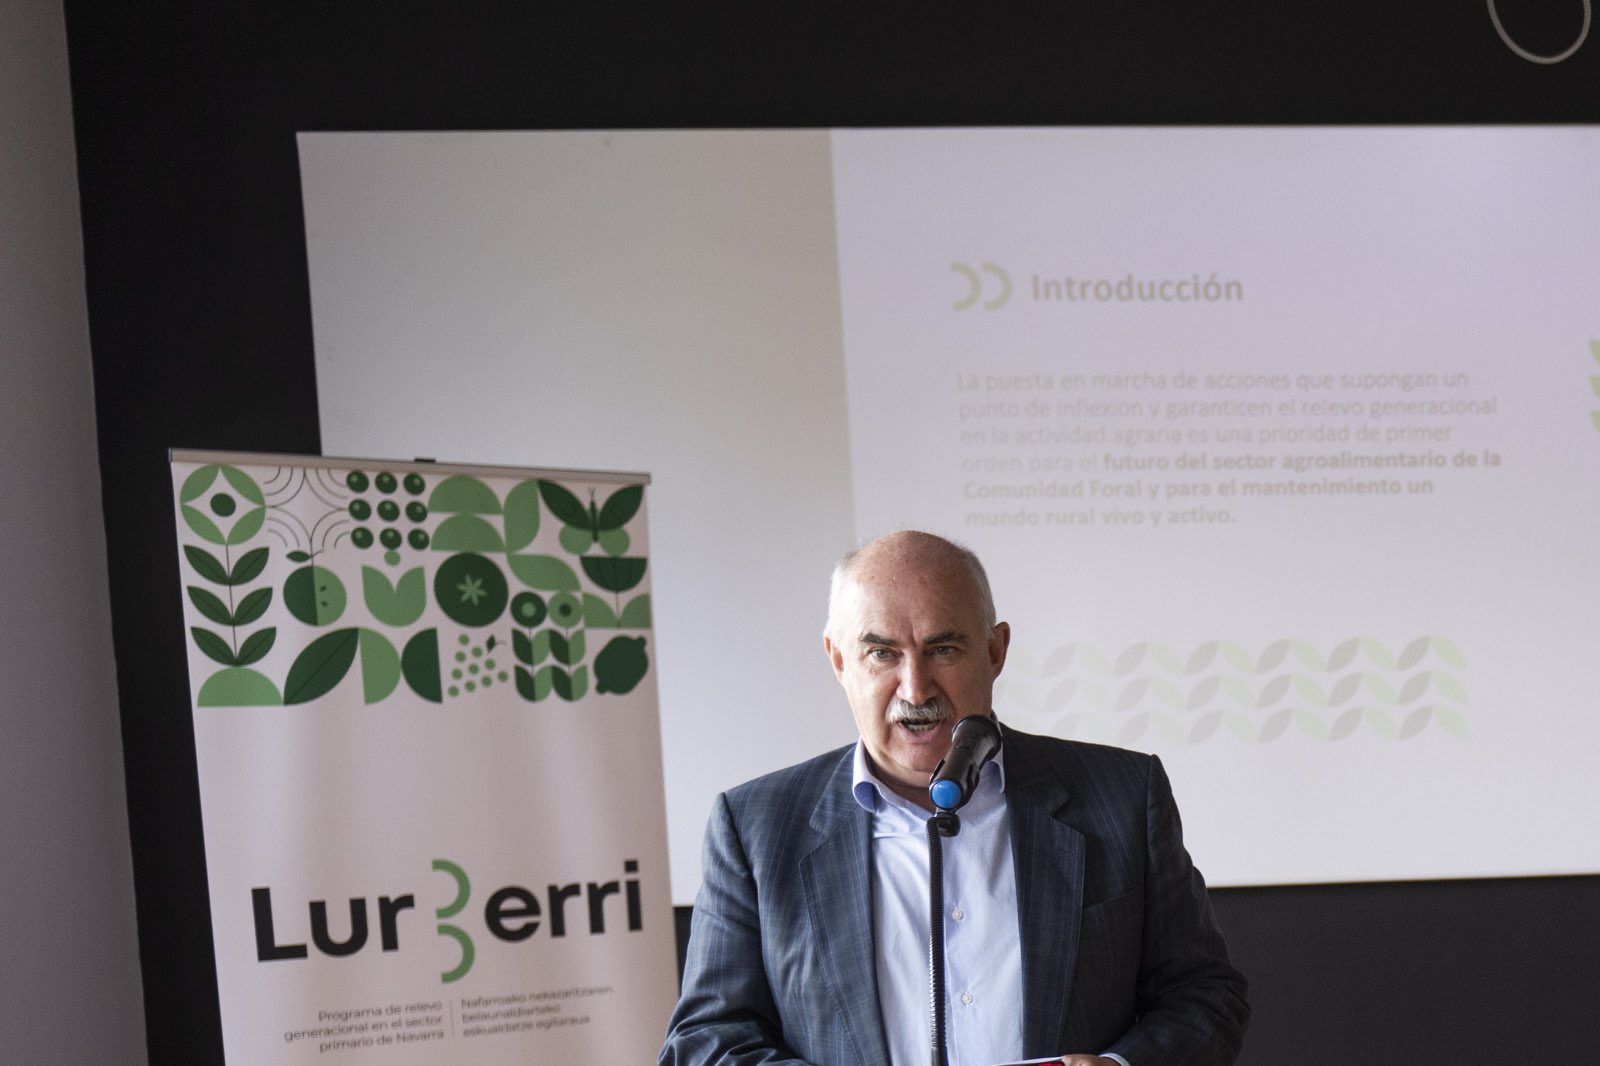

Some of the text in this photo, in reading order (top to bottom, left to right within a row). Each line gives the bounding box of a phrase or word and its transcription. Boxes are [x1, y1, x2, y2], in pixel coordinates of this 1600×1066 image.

[1032, 273, 1244, 303] Introducción
[958, 371, 1468, 392] La puesta en marcha de acciones que supongan un
[960, 401, 1019, 419] punto
[1026, 399, 1051, 416] de
[1149, 403, 1161, 419] y
[1166, 400, 1272, 420] garanticen
[1278, 398, 1295, 415] el
[1302, 397, 1364, 415] relevo
[1370, 396, 1497, 419] generacional
[960, 432, 985, 445] en
[1015, 426, 1105, 444] actividad
[1112, 427, 1181, 447] agraria
[1188, 429, 1210, 442] es
[1216, 427, 1251, 442] una
[1259, 425, 1349, 445] prioridad
[1356, 425, 1380, 442] de
[1387, 425, 1452, 442] primer
[1080, 454, 1097, 470] el
[1104, 454, 1169, 470] futuro
[1174, 453, 1207, 470] del
[1213, 454, 1275, 469] sector
[1282, 451, 1446, 472] agroalimentario
[1453, 450, 1477, 467] de
[1484, 449, 1501, 467] la
[964, 477, 1434, 500] Comunidad Foral y para el mantenimiento un
[966, 506, 1237, 528] mundo rural vivo y activo.
[318, 1000, 442, 1022] Programa de relevo
[284, 1014, 443, 1042] generacional en el sector
[319, 1029, 444, 1053] primario de Navarra
